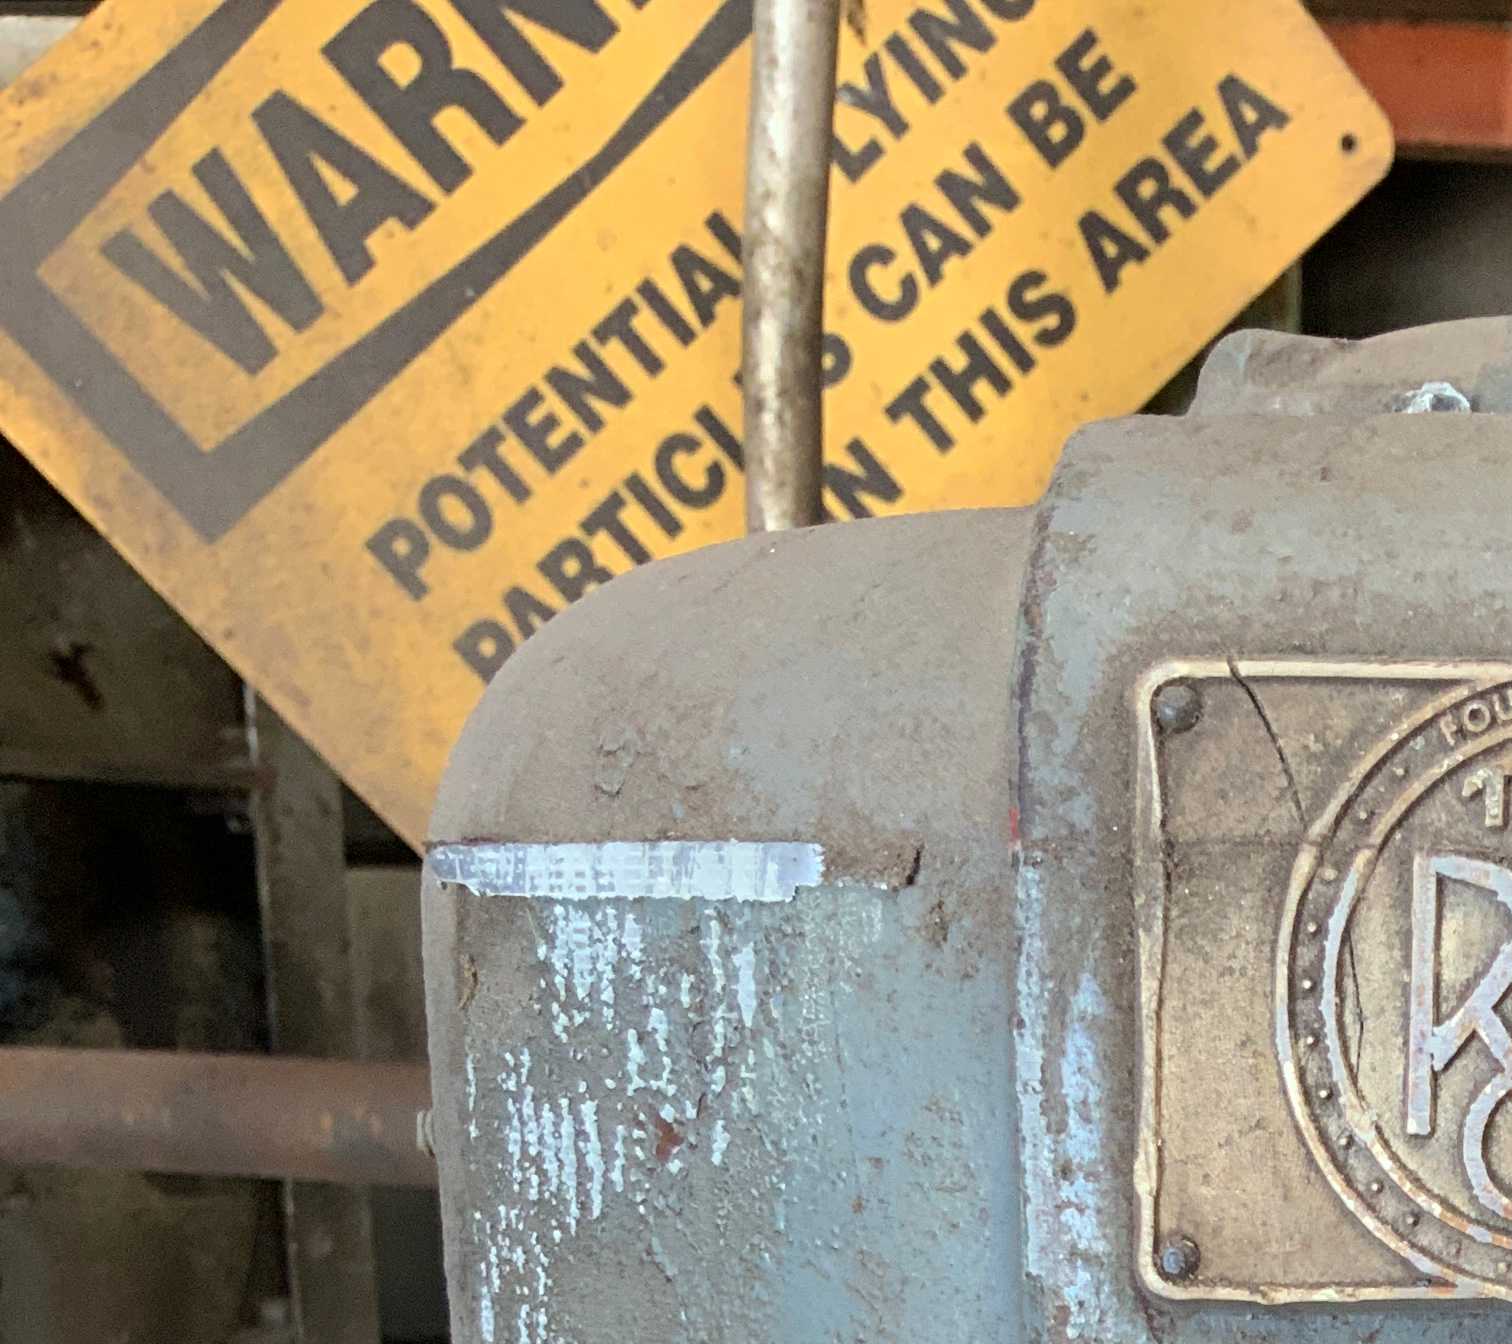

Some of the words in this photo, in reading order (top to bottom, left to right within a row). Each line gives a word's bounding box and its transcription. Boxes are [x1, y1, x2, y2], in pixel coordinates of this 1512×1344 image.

[100, 0, 651, 377] WARN
[822, 437, 904, 521] N
[883, 268, 1078, 455] THIS
[1077, 72, 1293, 294] AREA
[830, 0, 1036, 183] LYIN
[452, 332, 852, 687] PARTICL
[849, 142, 1023, 323] CAN
[1005, 26, 1139, 168] BE
